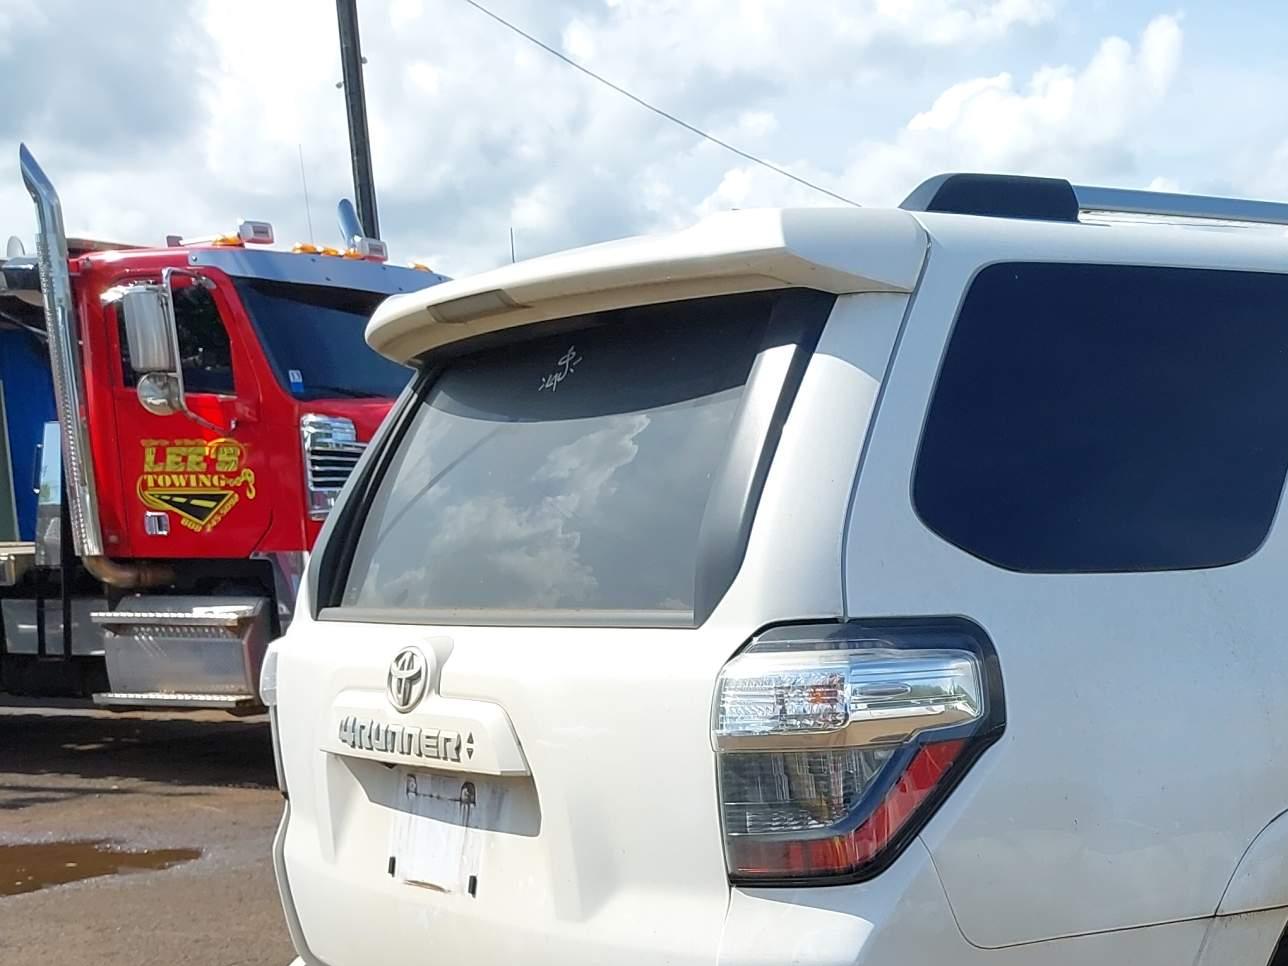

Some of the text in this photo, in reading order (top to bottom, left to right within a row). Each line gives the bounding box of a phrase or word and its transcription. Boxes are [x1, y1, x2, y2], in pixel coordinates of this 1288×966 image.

[141, 439, 240, 472] LEE'S
[143, 473, 226, 488] TOWING
[339, 716, 462, 762] 4RUNNER
